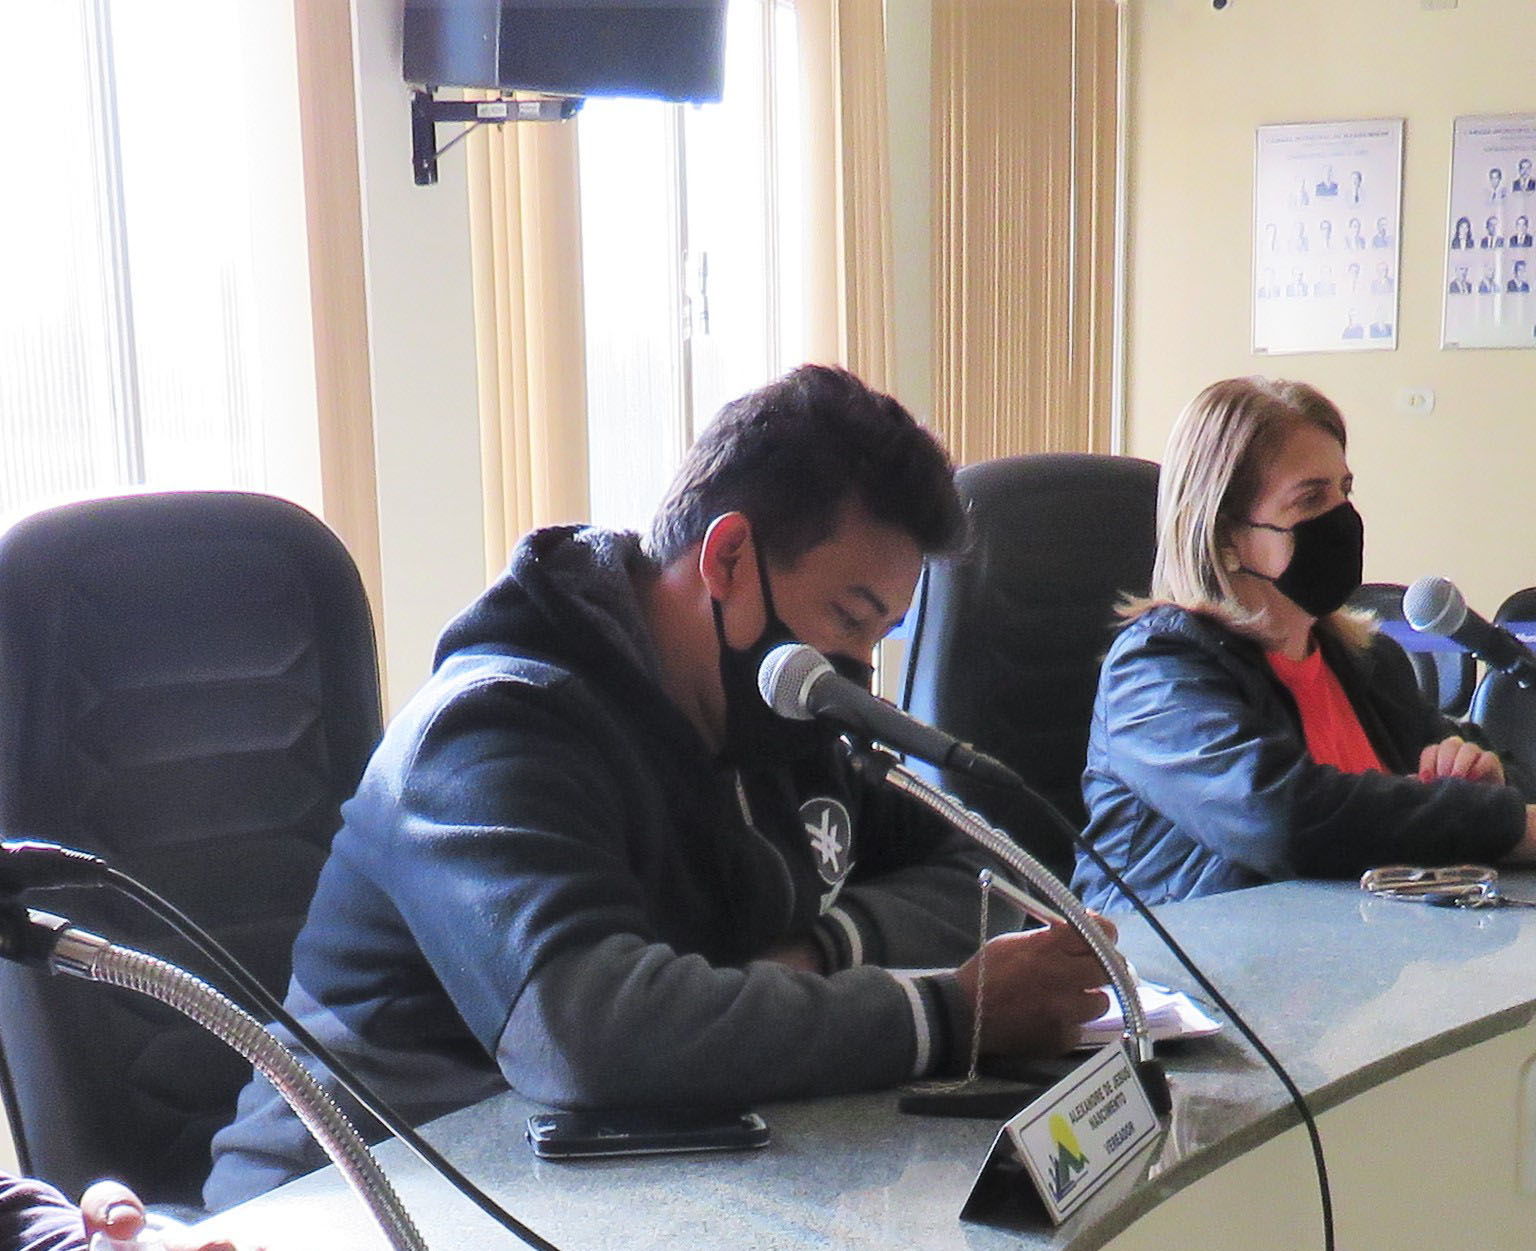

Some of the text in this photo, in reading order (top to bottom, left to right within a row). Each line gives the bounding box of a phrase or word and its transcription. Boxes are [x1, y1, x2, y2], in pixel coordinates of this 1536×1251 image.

[1069, 1066, 1132, 1124] ALEXANDRE DE JESUS
[1088, 1091, 1127, 1130] NASCIMENTO
[1105, 1121, 1135, 1154] VEREADOR
